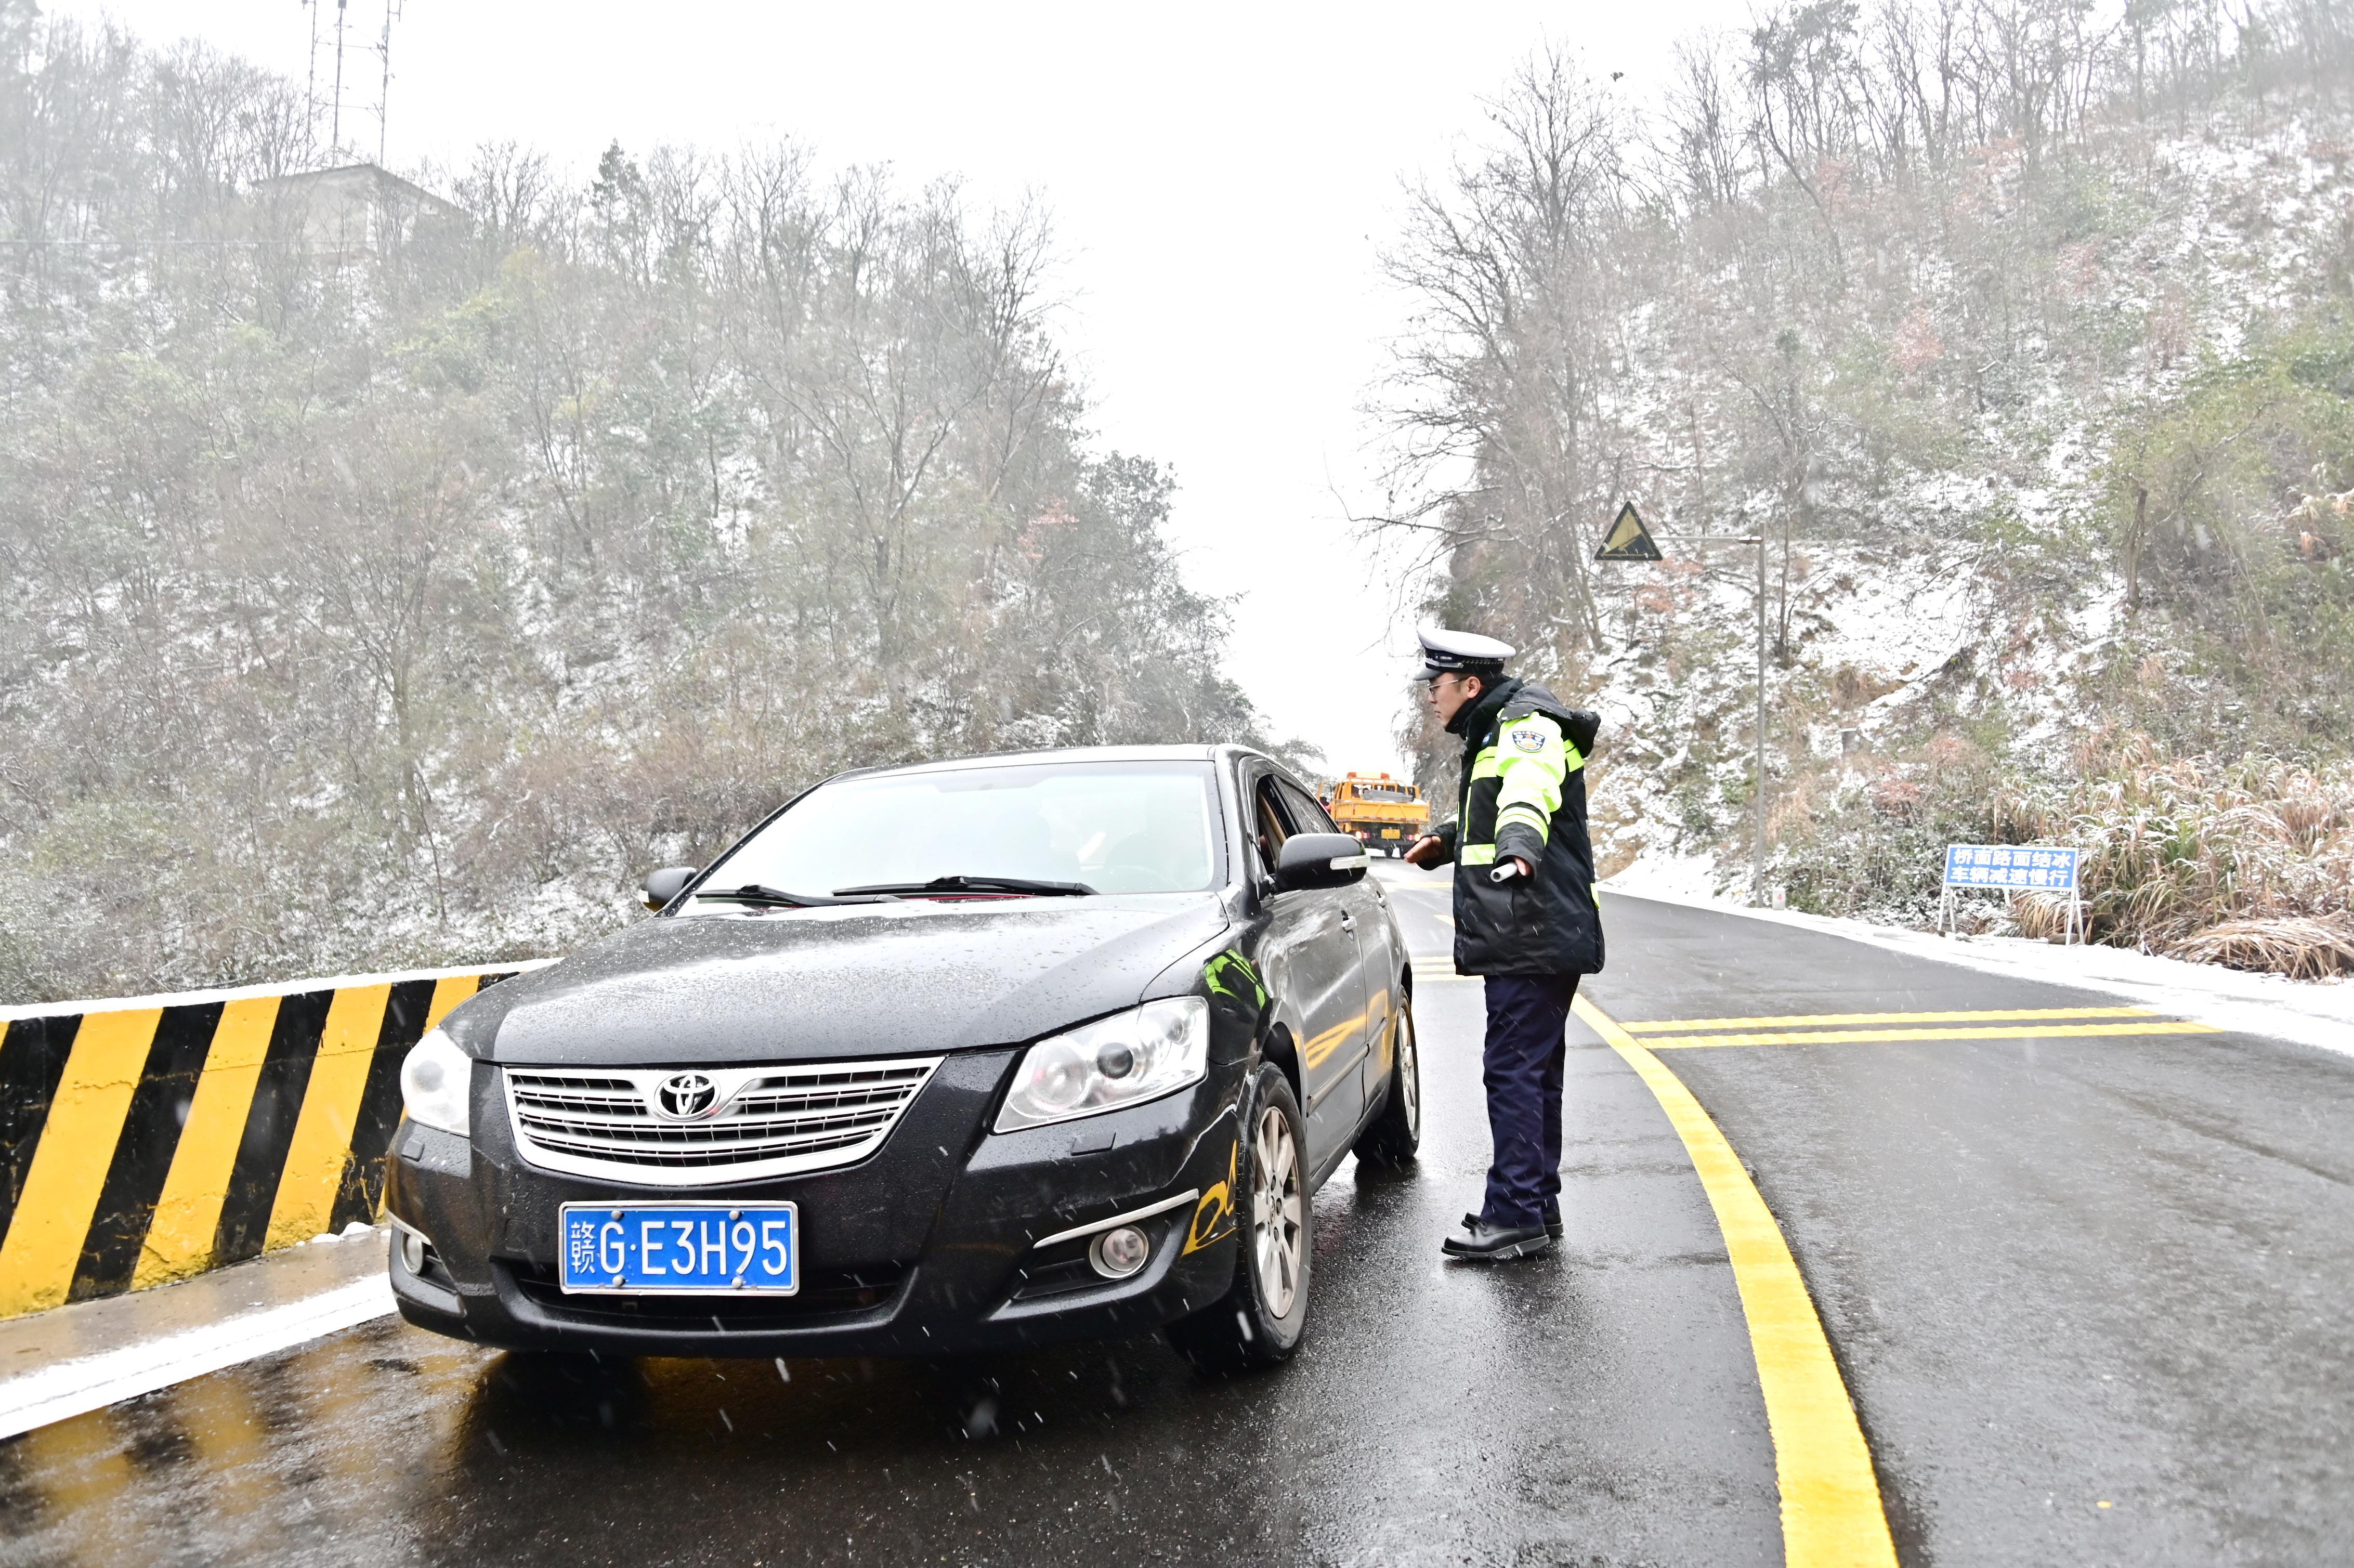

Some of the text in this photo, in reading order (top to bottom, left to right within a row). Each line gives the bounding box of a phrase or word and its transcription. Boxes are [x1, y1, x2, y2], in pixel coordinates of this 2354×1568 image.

[1953, 848, 2071, 868] 桥面路面结冰
[1950, 866, 2069, 886] 车辆减速慢行
